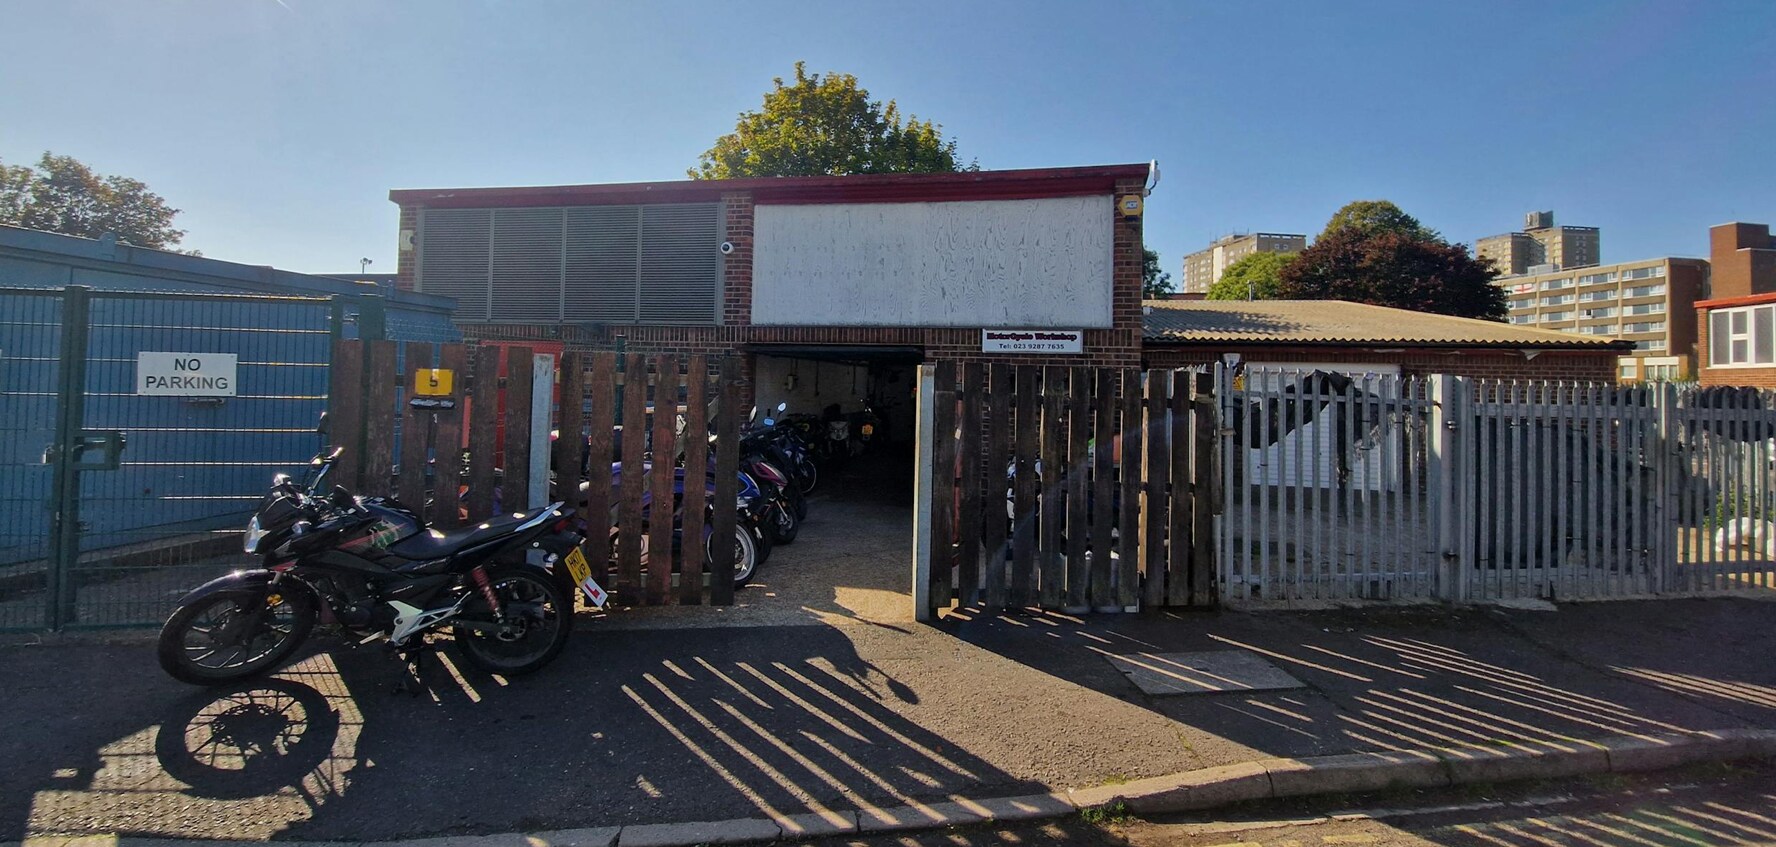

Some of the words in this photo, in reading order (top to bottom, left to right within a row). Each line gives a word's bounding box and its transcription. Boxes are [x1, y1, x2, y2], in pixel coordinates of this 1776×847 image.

[1035, 333, 1077, 341] Workshop
[174, 358, 201, 371] NO
[145, 375, 228, 390] PARKING
[429, 375, 438, 387] 5
[584, 583, 601, 600] L
